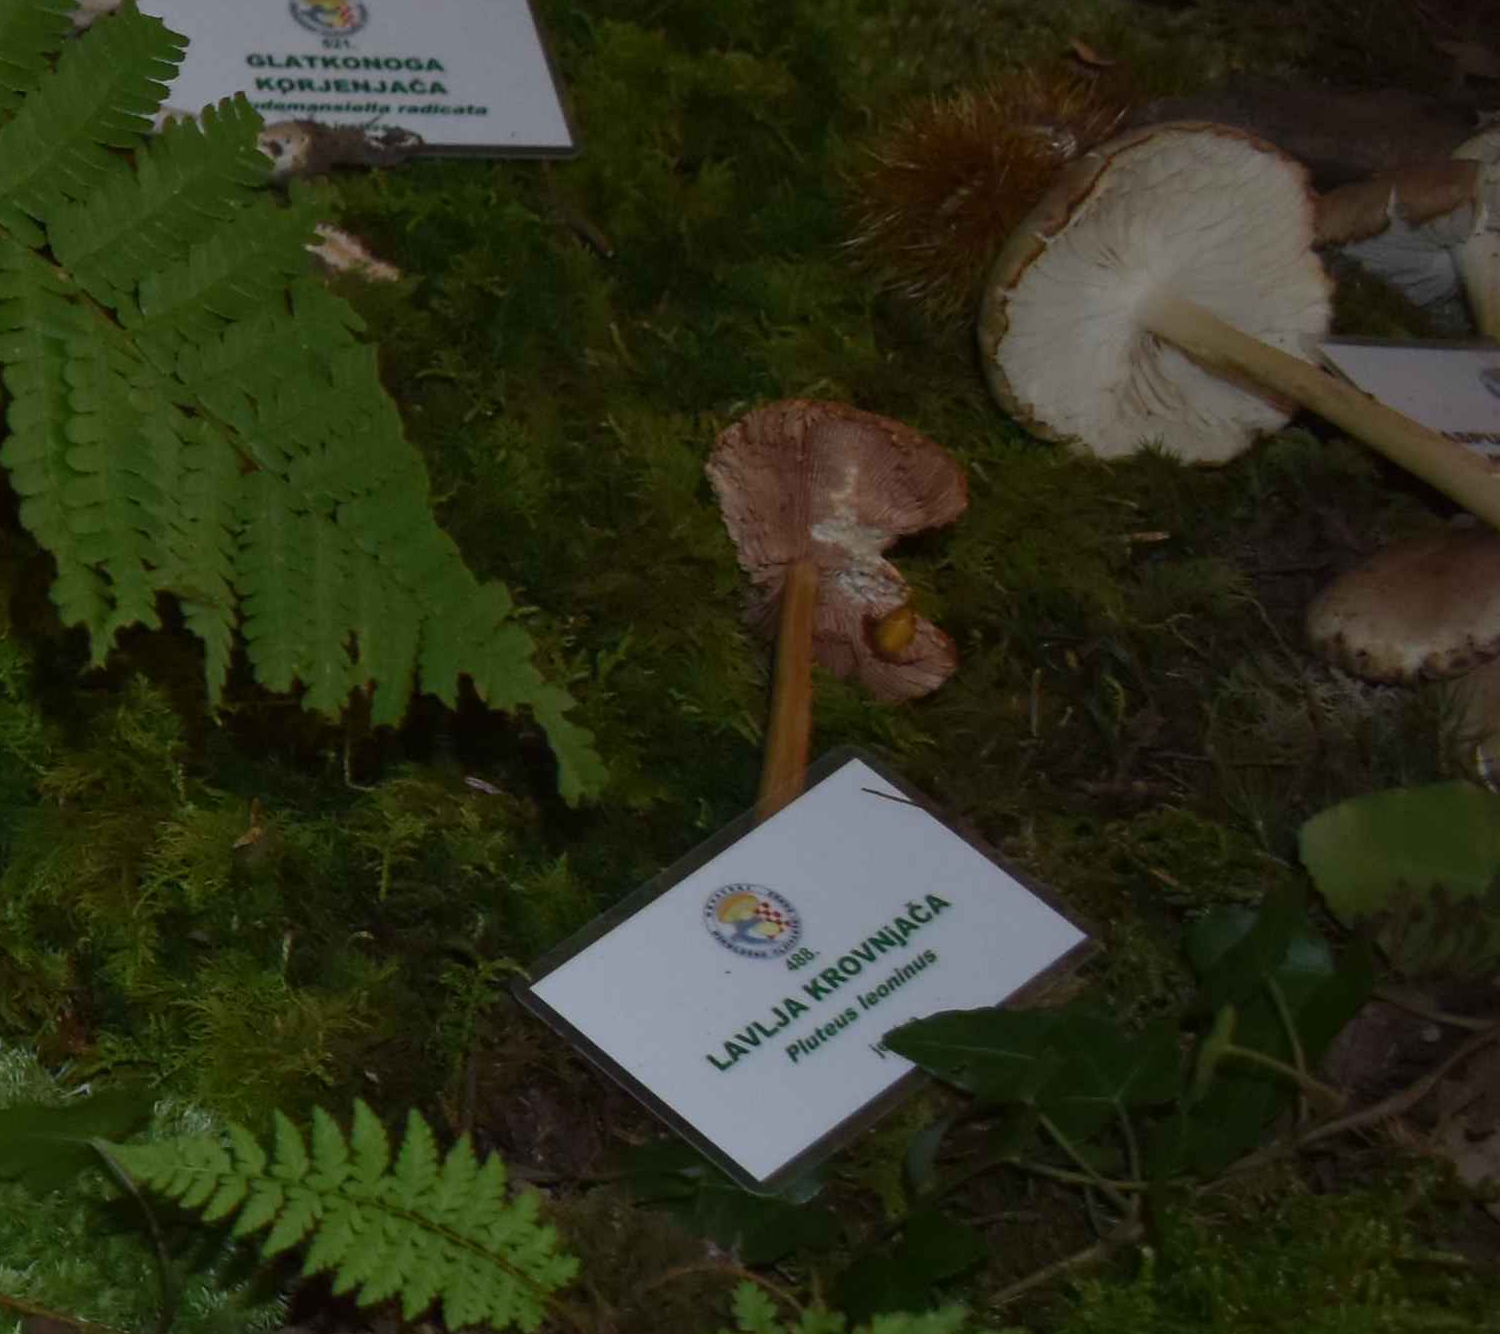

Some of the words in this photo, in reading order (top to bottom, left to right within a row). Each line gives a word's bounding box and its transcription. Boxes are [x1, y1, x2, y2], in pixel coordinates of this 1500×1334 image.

[246, 54, 445, 72] GLATKONOGA
[255, 78, 448, 95] KORJENJAČA
[398, 104, 489, 116] radicata
[786, 948, 821, 971] 488.
[785, 1006, 859, 1063] Pluteus
[857, 948, 938, 1010] leoninus
[706, 998, 812, 1071] LAVLJA
